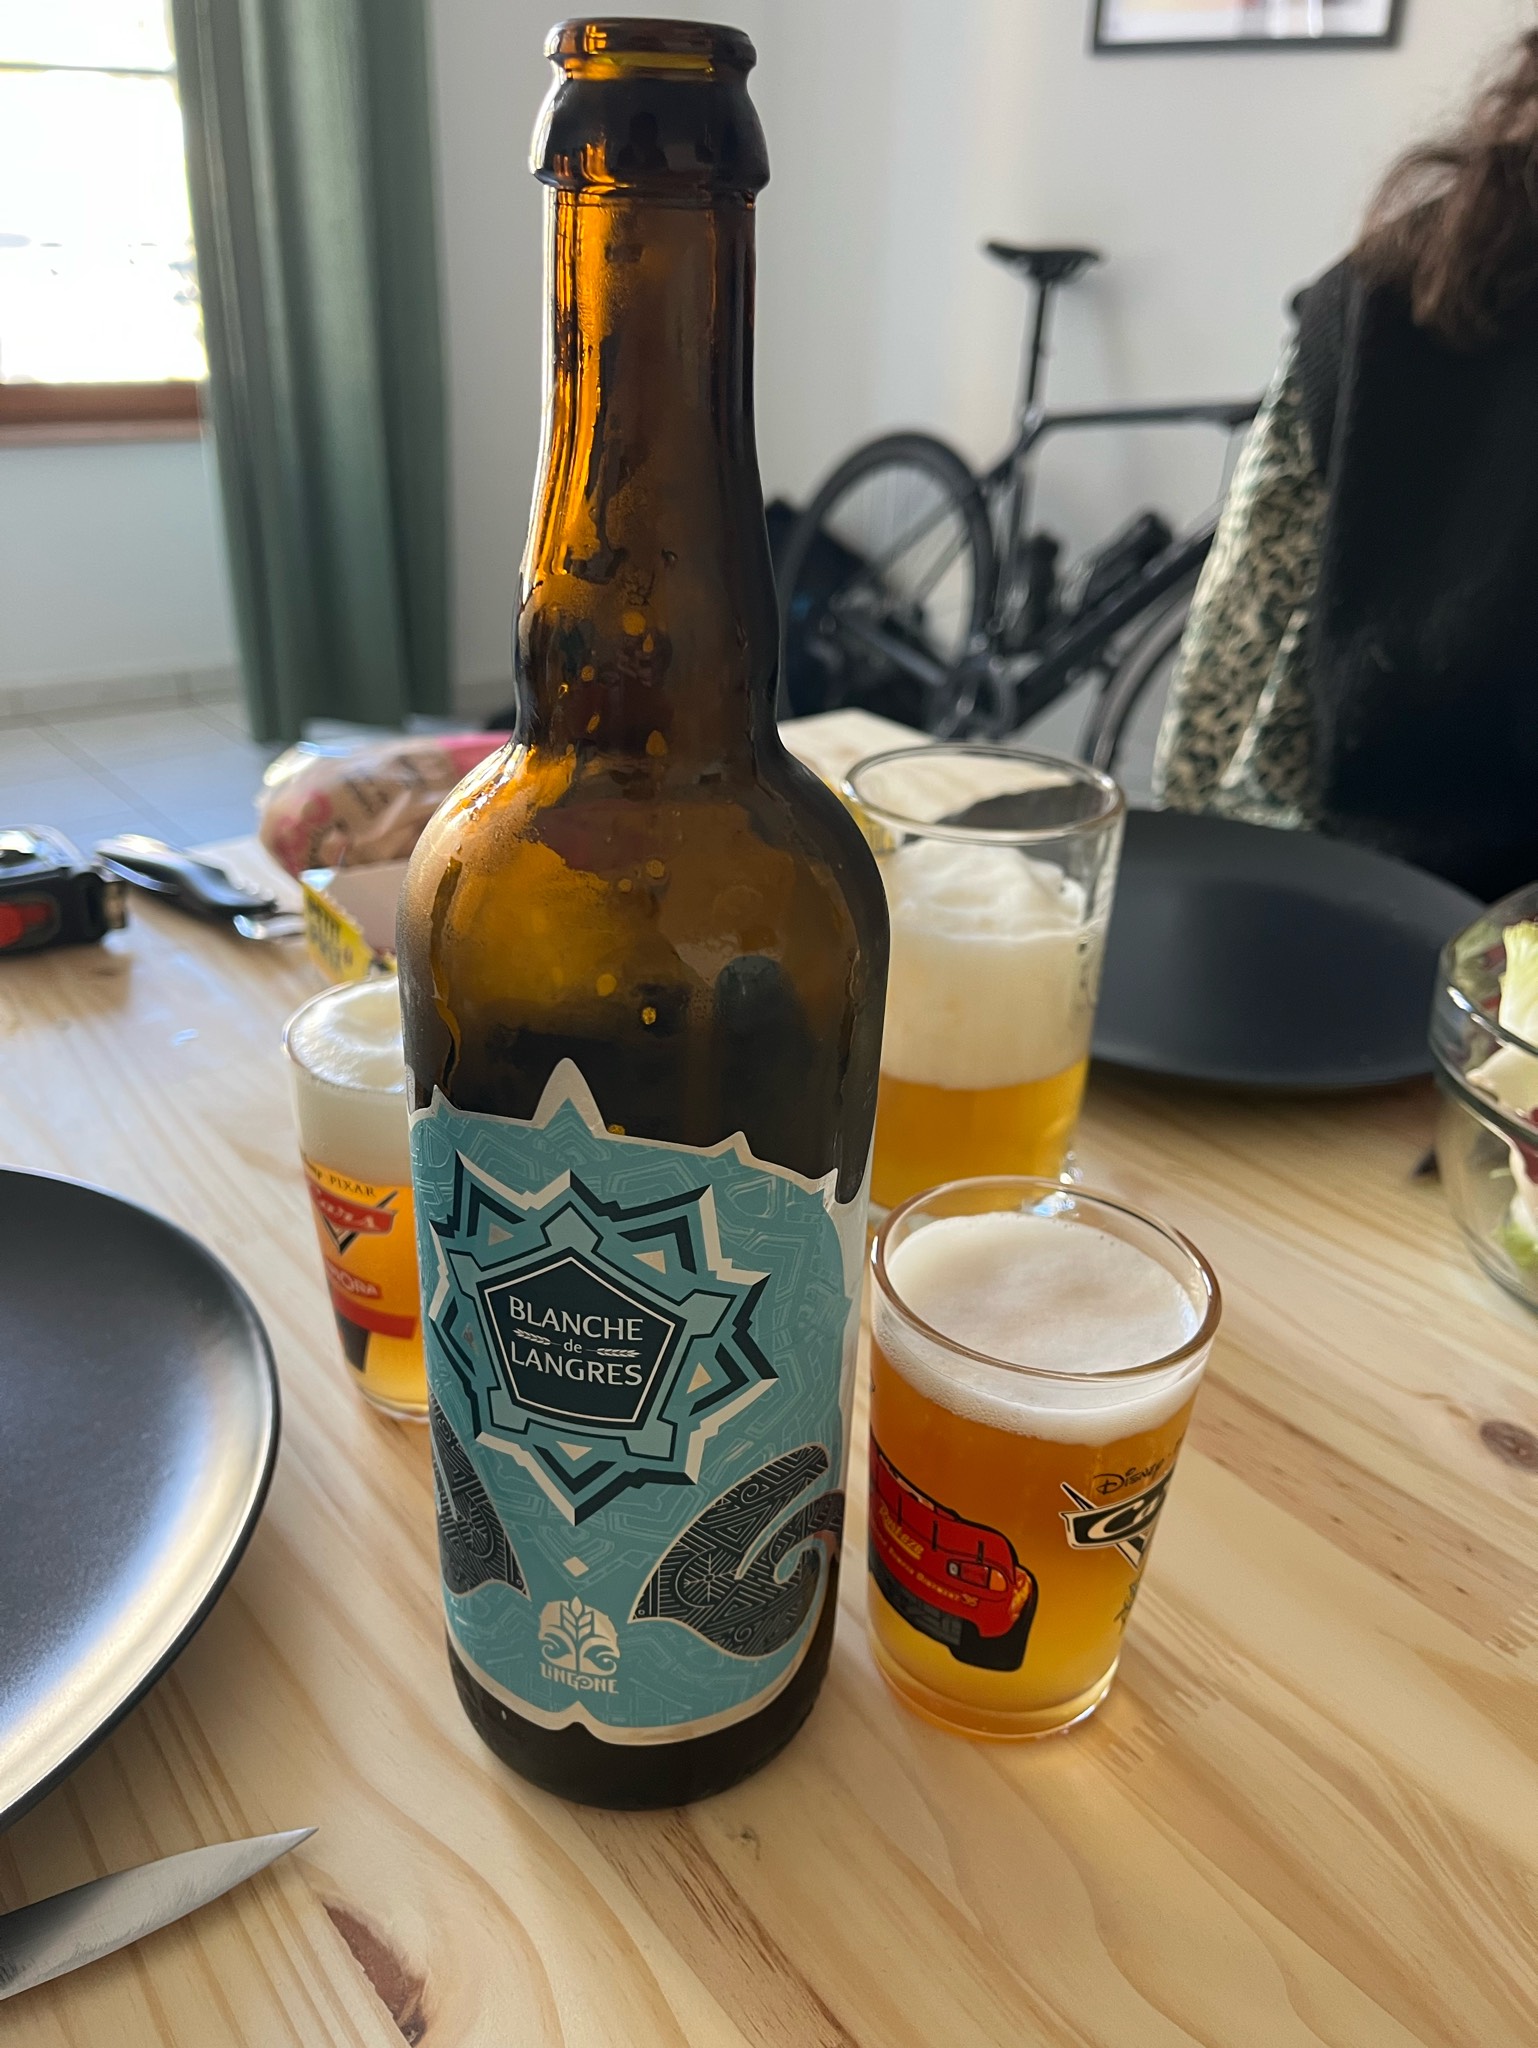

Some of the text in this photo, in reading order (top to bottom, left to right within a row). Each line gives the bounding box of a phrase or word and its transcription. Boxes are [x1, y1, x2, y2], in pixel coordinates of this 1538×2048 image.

[329, 1174, 376, 1198] PIXAR
[509, 1295, 643, 1341] BLANCHE
[511, 1340, 643, 1386] LANGRES
[563, 1339, 583, 1353] de
